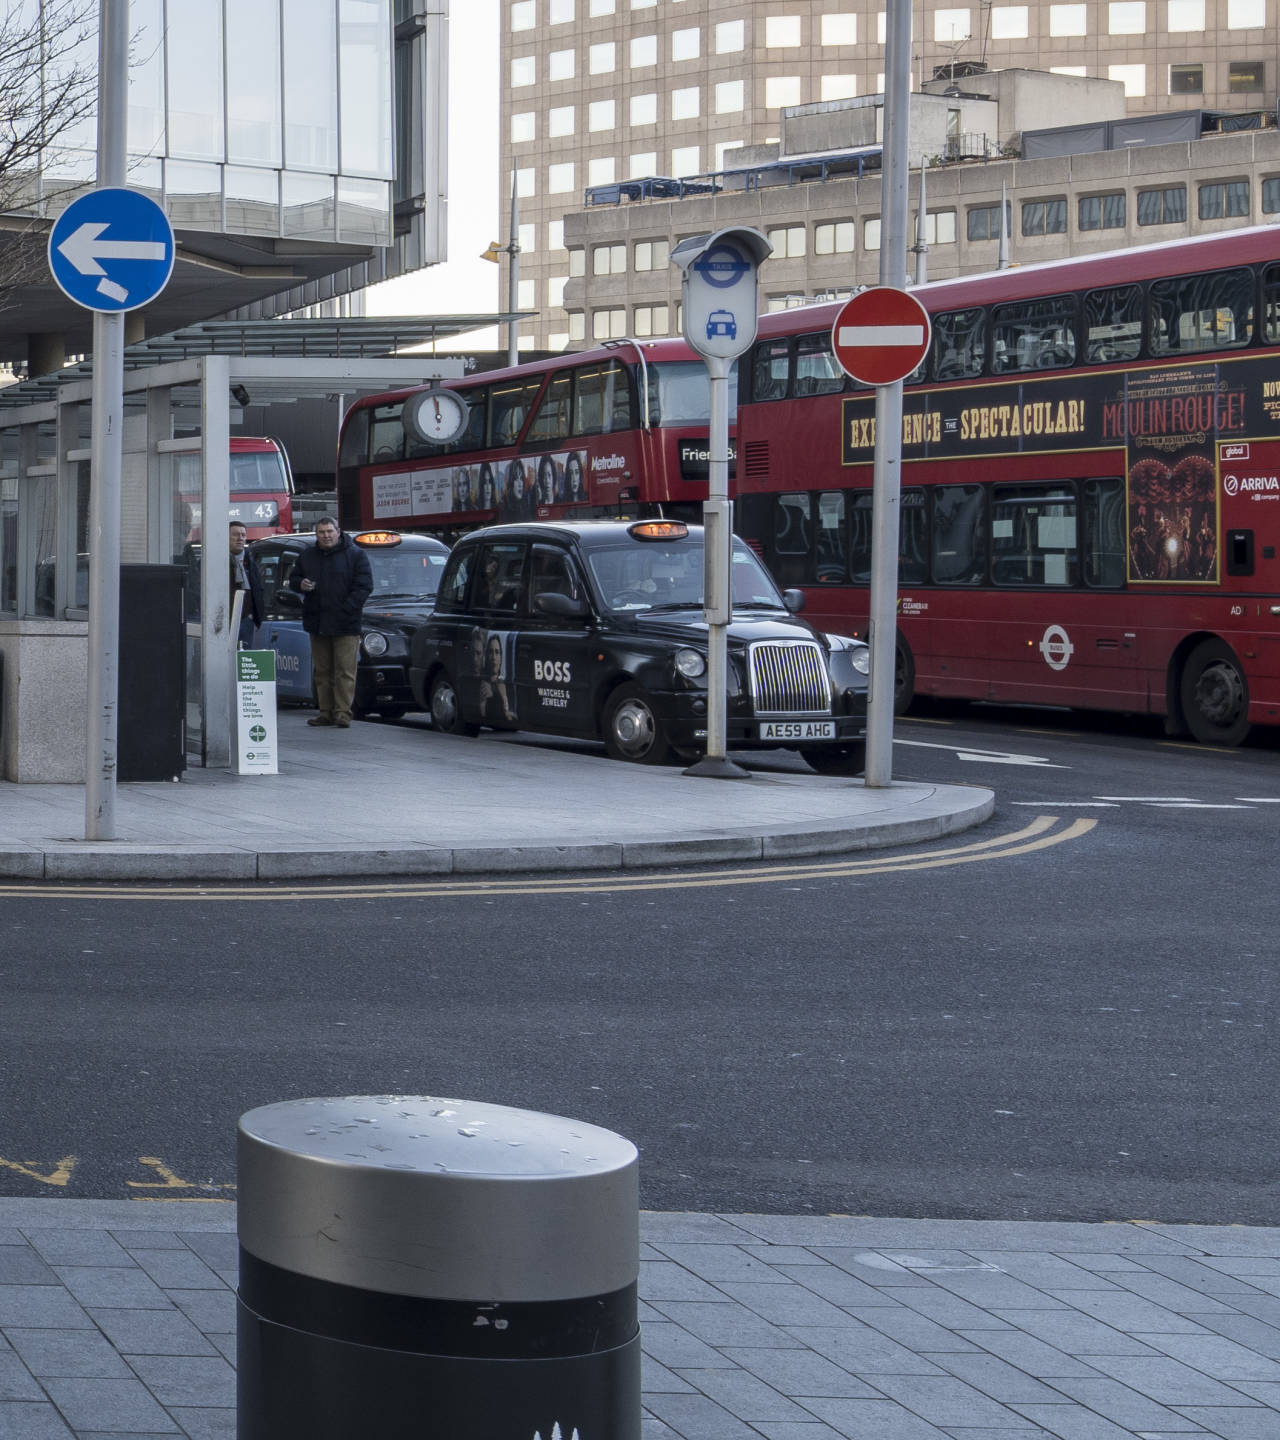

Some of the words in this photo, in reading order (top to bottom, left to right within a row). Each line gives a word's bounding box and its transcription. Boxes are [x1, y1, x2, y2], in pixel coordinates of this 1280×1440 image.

[1103, 399, 1167, 439] MOULIN
[1171, 392, 1246, 433] ROUGE!
[851, 412, 941, 448] EXENCE
[945, 421, 957, 430] THE
[960, 399, 1085, 440] SPECTACULAR!
[1225, 446, 1244, 458] global
[591, 453, 626, 471] Metroline
[1240, 477, 1280, 492] ARRIVA
[254, 503, 273, 518] 43
[534, 659, 572, 683] BOSS
[537, 687, 565, 698] WATCHES
[542, 697, 568, 708] JEWELRY
[766, 724, 802, 737] AE59
[805, 723, 831, 737] AHG
